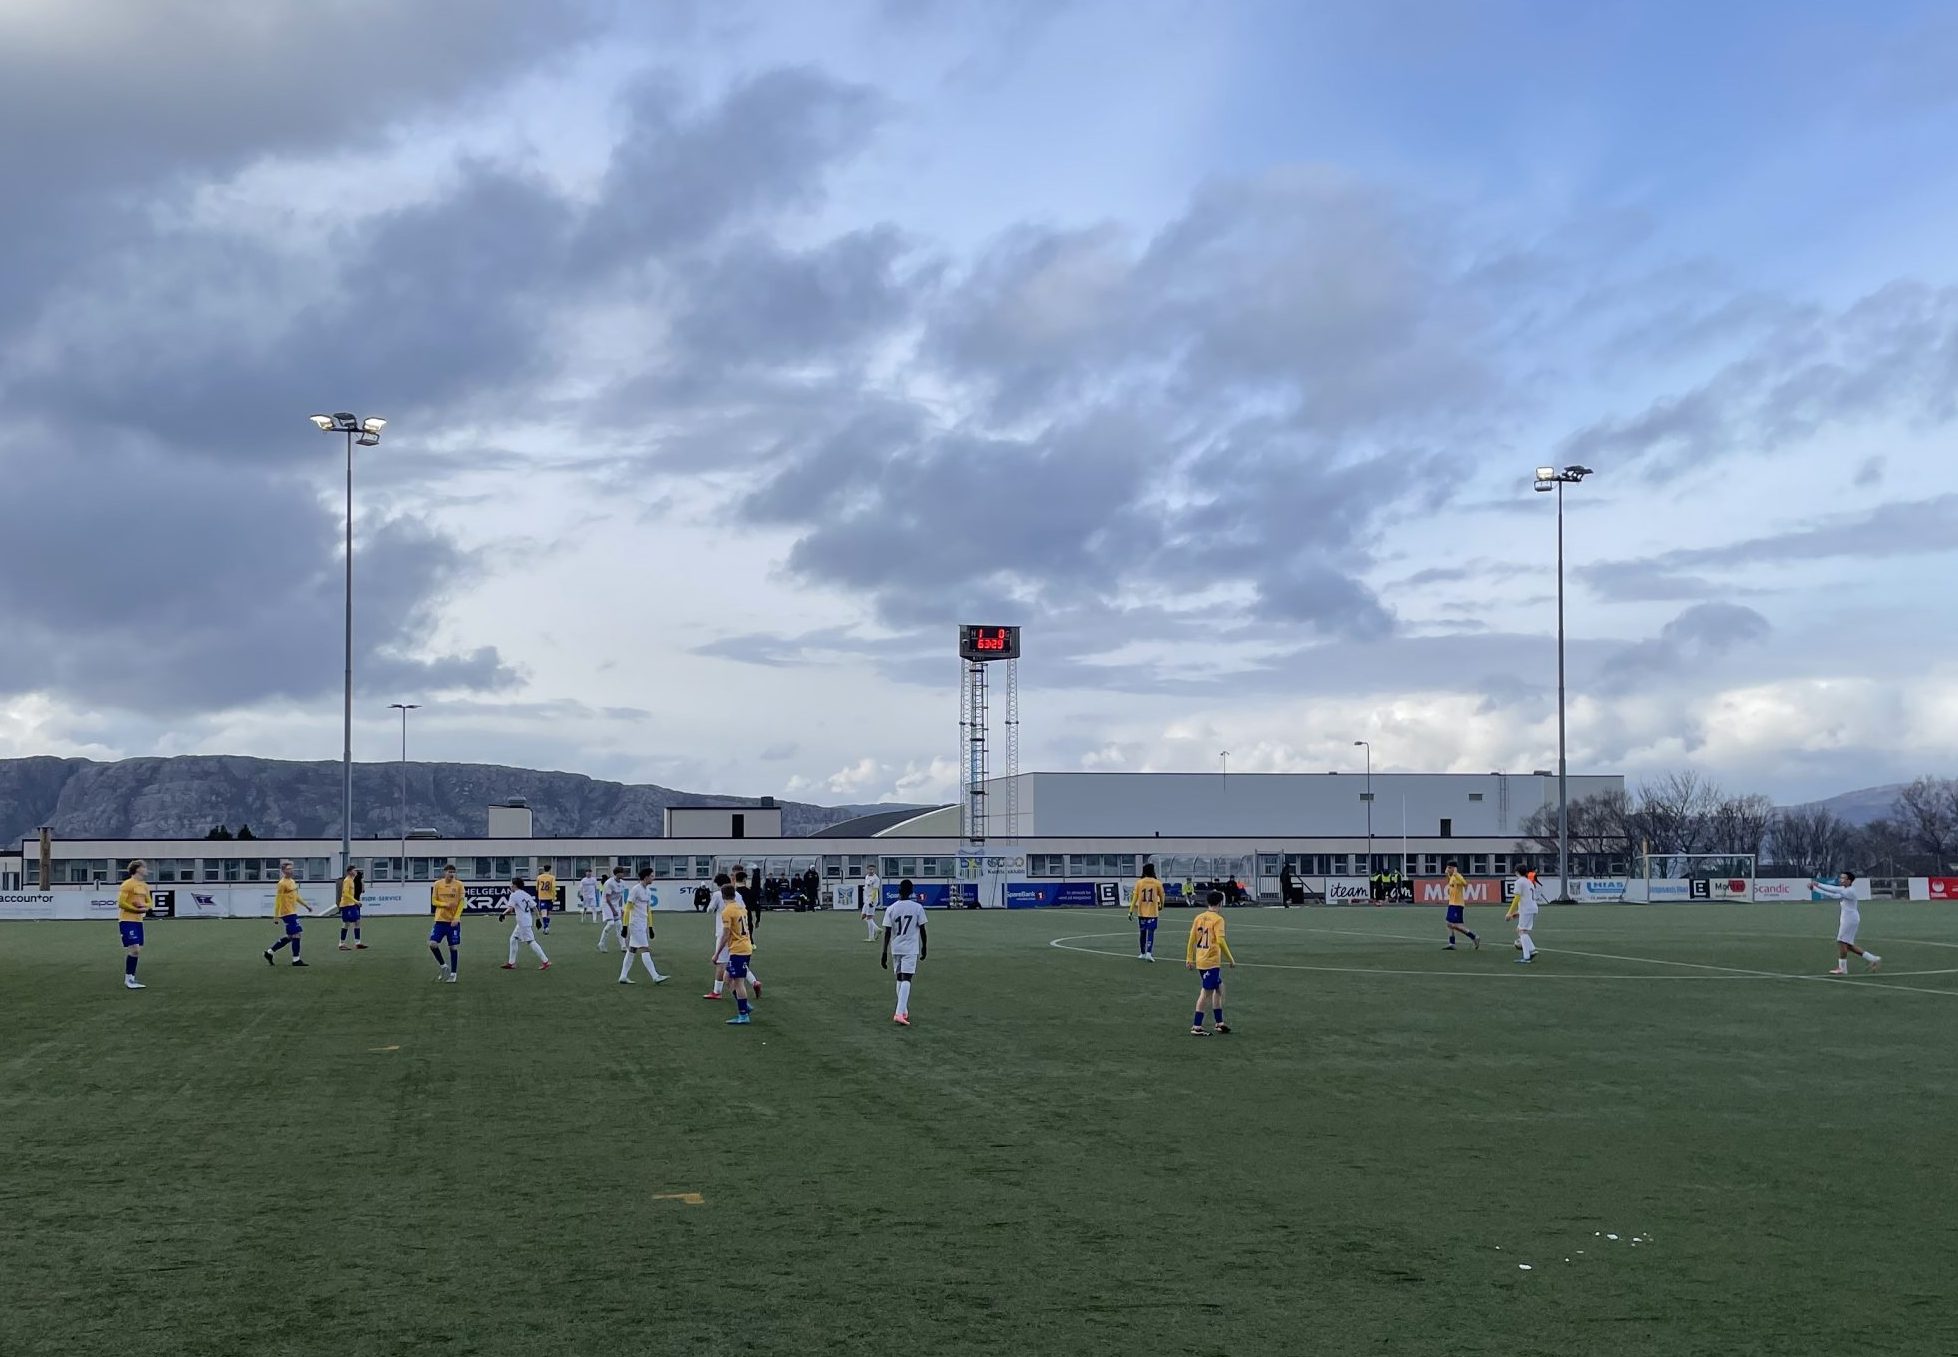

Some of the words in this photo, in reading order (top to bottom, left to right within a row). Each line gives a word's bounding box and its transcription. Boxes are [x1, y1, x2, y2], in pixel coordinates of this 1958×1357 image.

[979, 628, 983, 638] 1
[998, 629, 1005, 638] 0
[465, 887, 513, 895] HELGELAN
[1330, 882, 1368, 898] iteam
[1754, 883, 1790, 893] Scandic
[0, 894, 54, 902] accountor
[1142, 889, 1154, 903] 11
[895, 915, 913, 936] 17
[1197, 927, 1209, 949] 21
